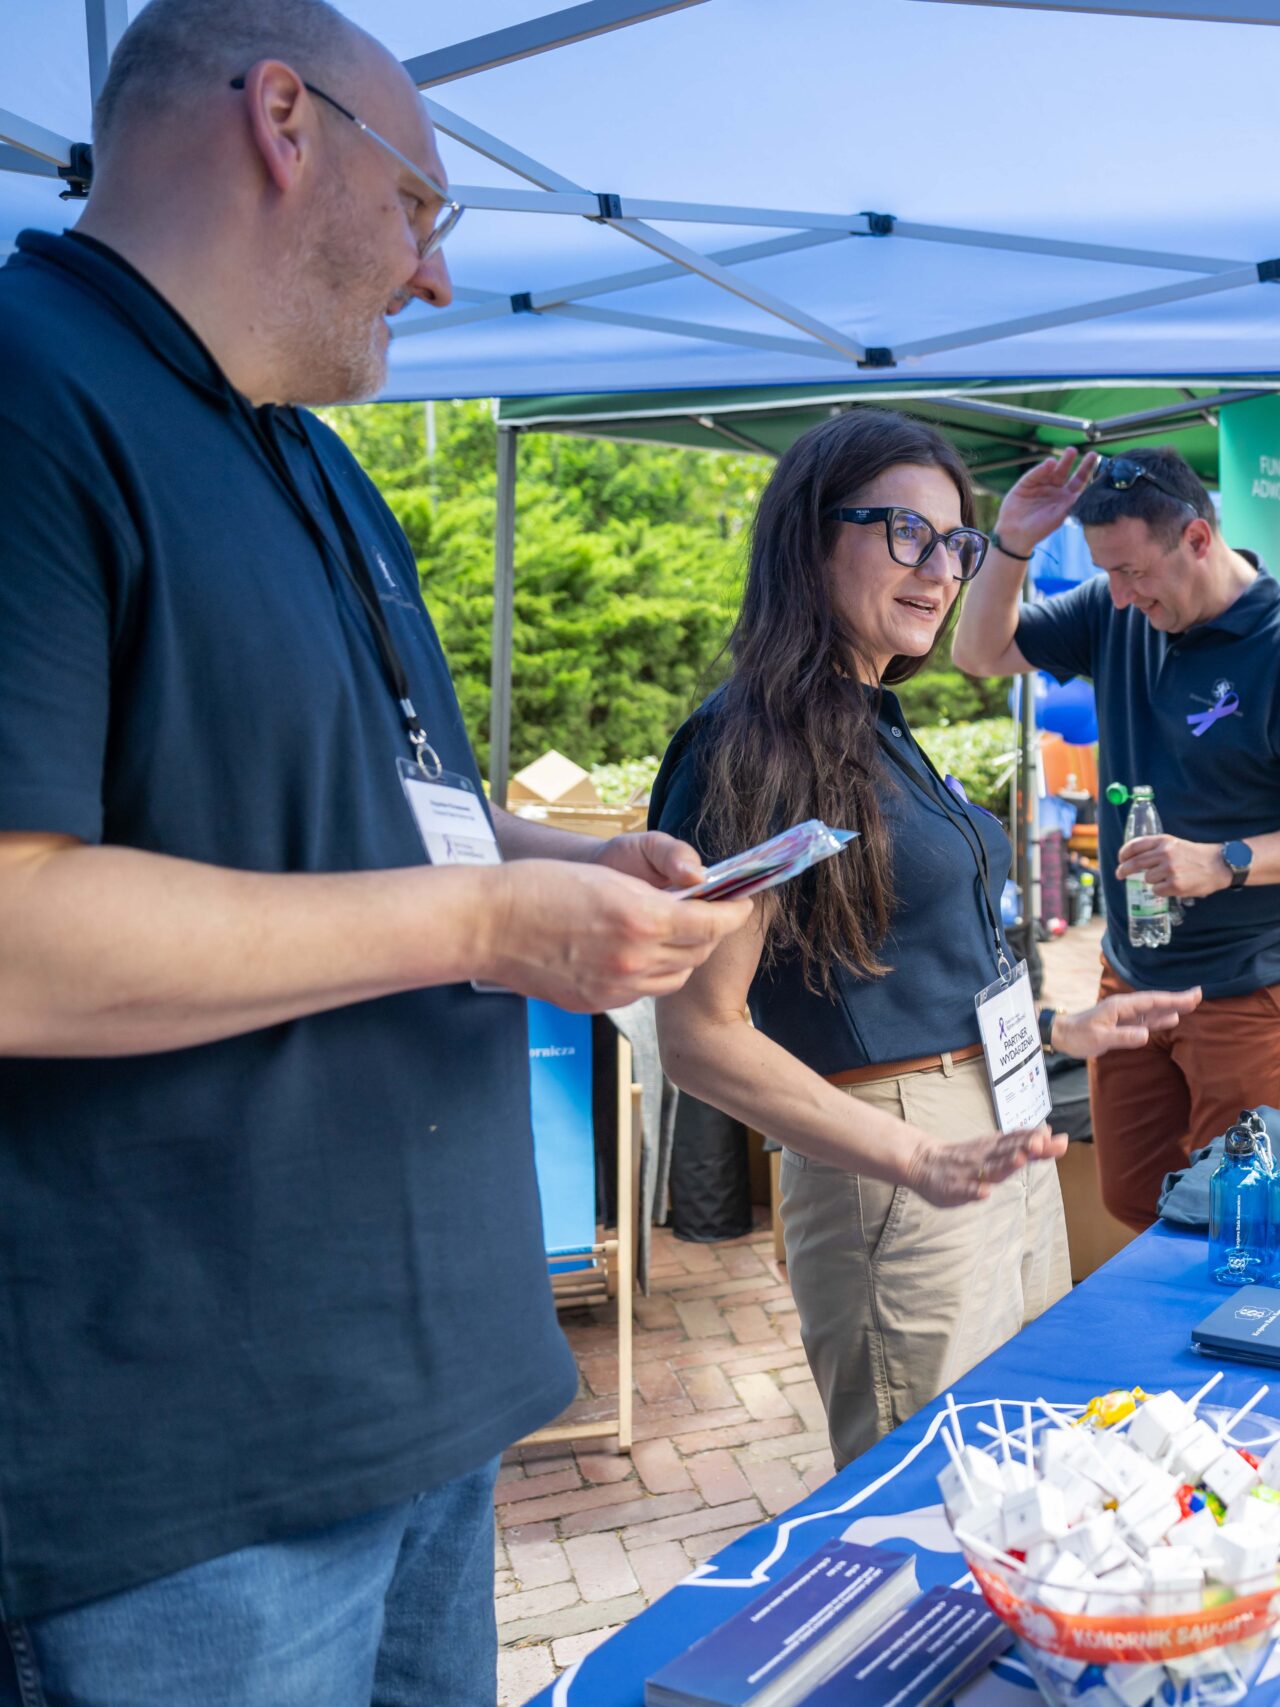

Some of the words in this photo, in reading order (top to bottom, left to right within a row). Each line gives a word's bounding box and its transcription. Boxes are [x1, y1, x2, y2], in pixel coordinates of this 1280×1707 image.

[999, 1034, 1034, 1067] WYDARZENIA
[1003, 1026, 1028, 1051] PARTNER
[529, 1045, 576, 1058] ornicza
